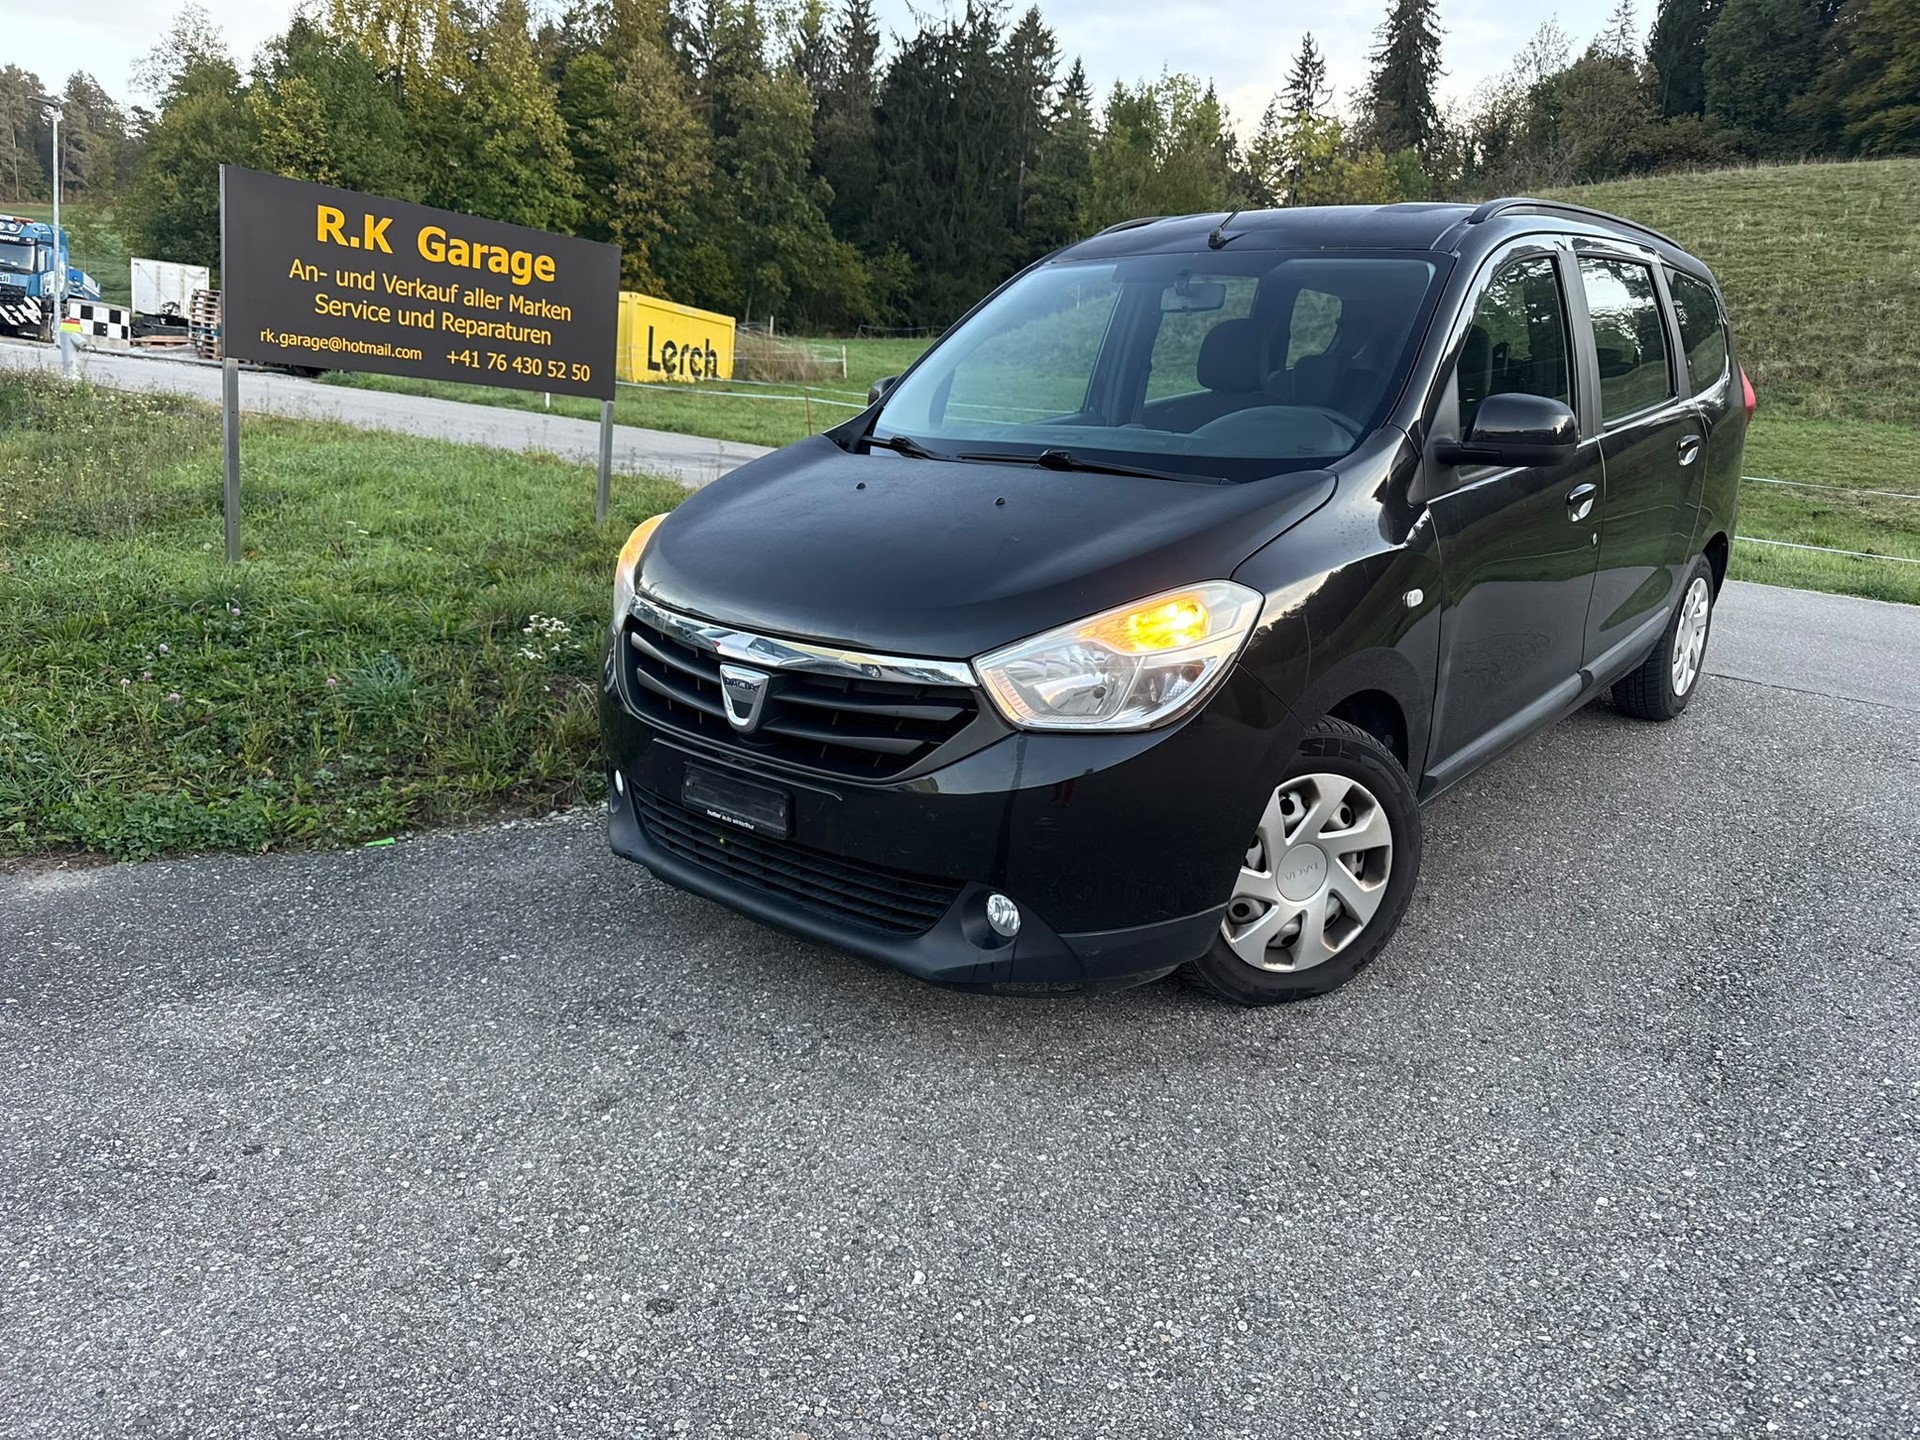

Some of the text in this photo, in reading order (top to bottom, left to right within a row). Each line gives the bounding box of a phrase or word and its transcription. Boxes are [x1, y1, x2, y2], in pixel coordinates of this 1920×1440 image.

[316, 204, 556, 286] R.K Garage
[288, 258, 572, 321] An- und Verkauf aller Marken
[260, 328, 423, 360] rk.garage@hotmail.com
[314, 293, 552, 345] Service und Reparaturen
[446, 350, 591, 382] +41 76 430 52 50
[647, 325, 718, 379] Lerch
[725, 677, 757, 692] DACIA
